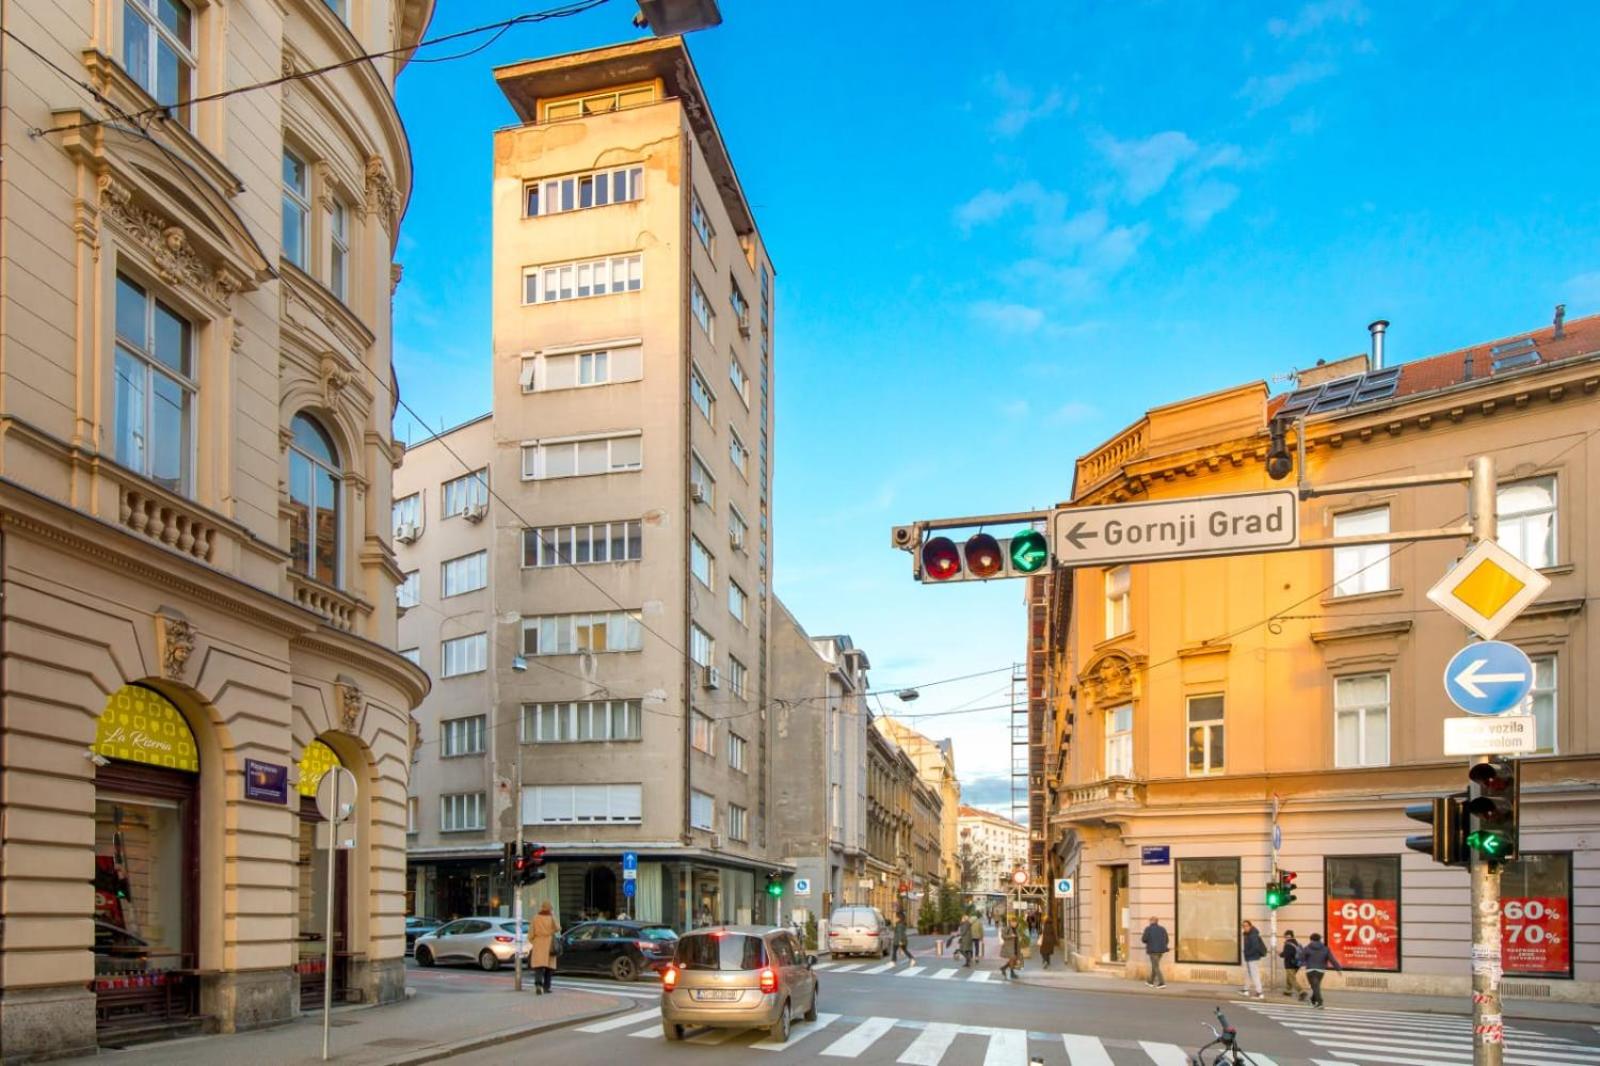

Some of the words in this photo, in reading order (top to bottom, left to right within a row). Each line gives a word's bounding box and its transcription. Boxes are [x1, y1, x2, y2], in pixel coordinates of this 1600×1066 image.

[1104, 514, 1196, 546] Gornji
[1208, 506, 1283, 537] Grad
[1488, 721, 1524, 734] vozila
[1333, 903, 1390, 920] -60%
[1333, 925, 1390, 943] -70%
